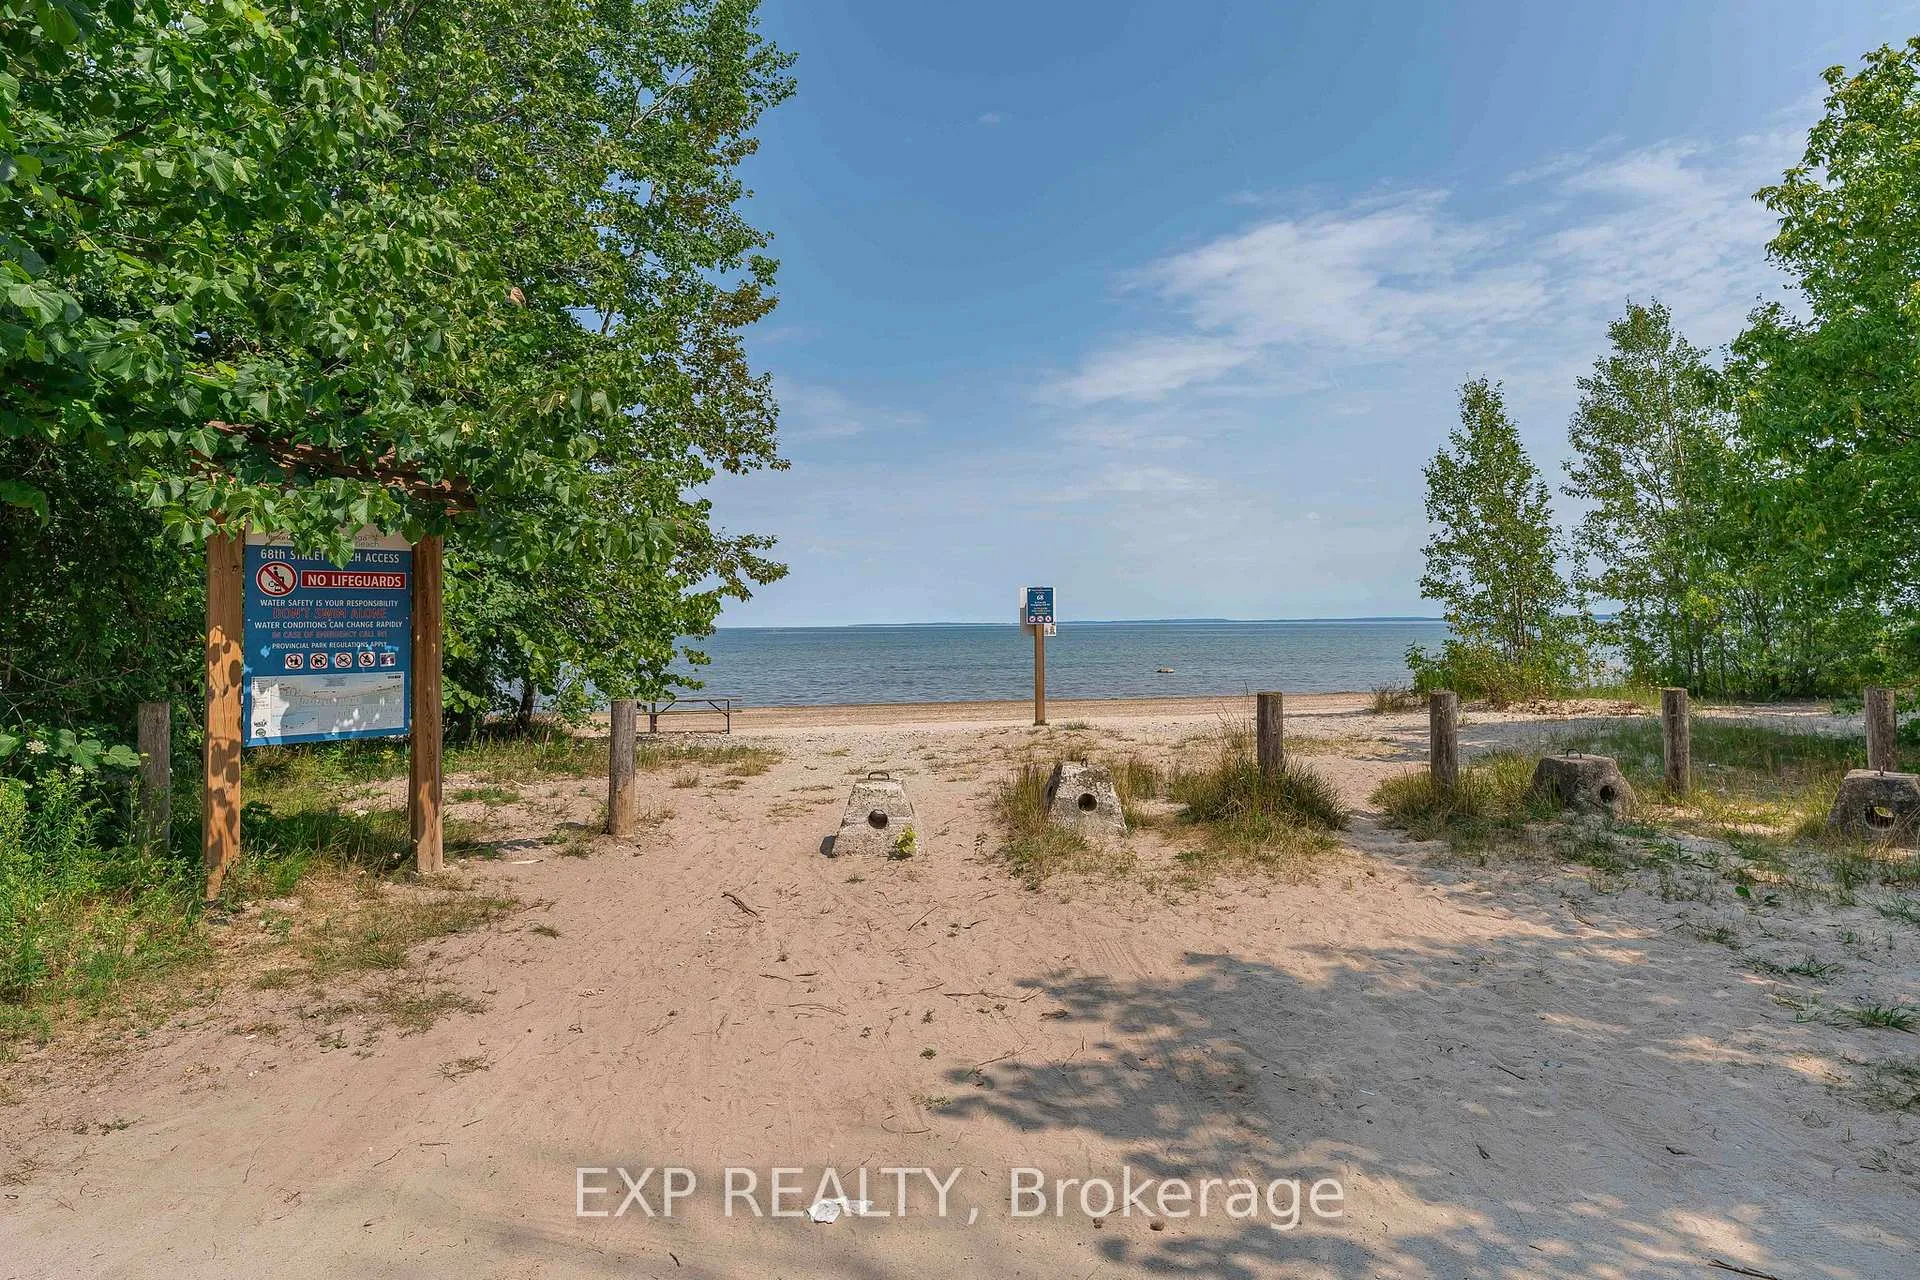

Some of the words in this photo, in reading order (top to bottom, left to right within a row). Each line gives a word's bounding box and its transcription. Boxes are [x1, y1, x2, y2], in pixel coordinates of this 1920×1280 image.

[260, 548, 285, 559] 68th
[365, 552, 399, 563] ACCESS
[308, 575, 326, 586] NO
[331, 575, 401, 587] LIFEGUARDS
[260, 599, 285, 607] WATER
[289, 599, 313, 607] SAFETY
[316, 599, 323, 607] IS
[325, 599, 344, 607] YOUR
[346, 599, 399, 607] RESPONSIBILITY
[351, 608, 387, 618] ALONE
[283, 621, 327, 629] CONDITIONS
[329, 621, 344, 629] CAN
